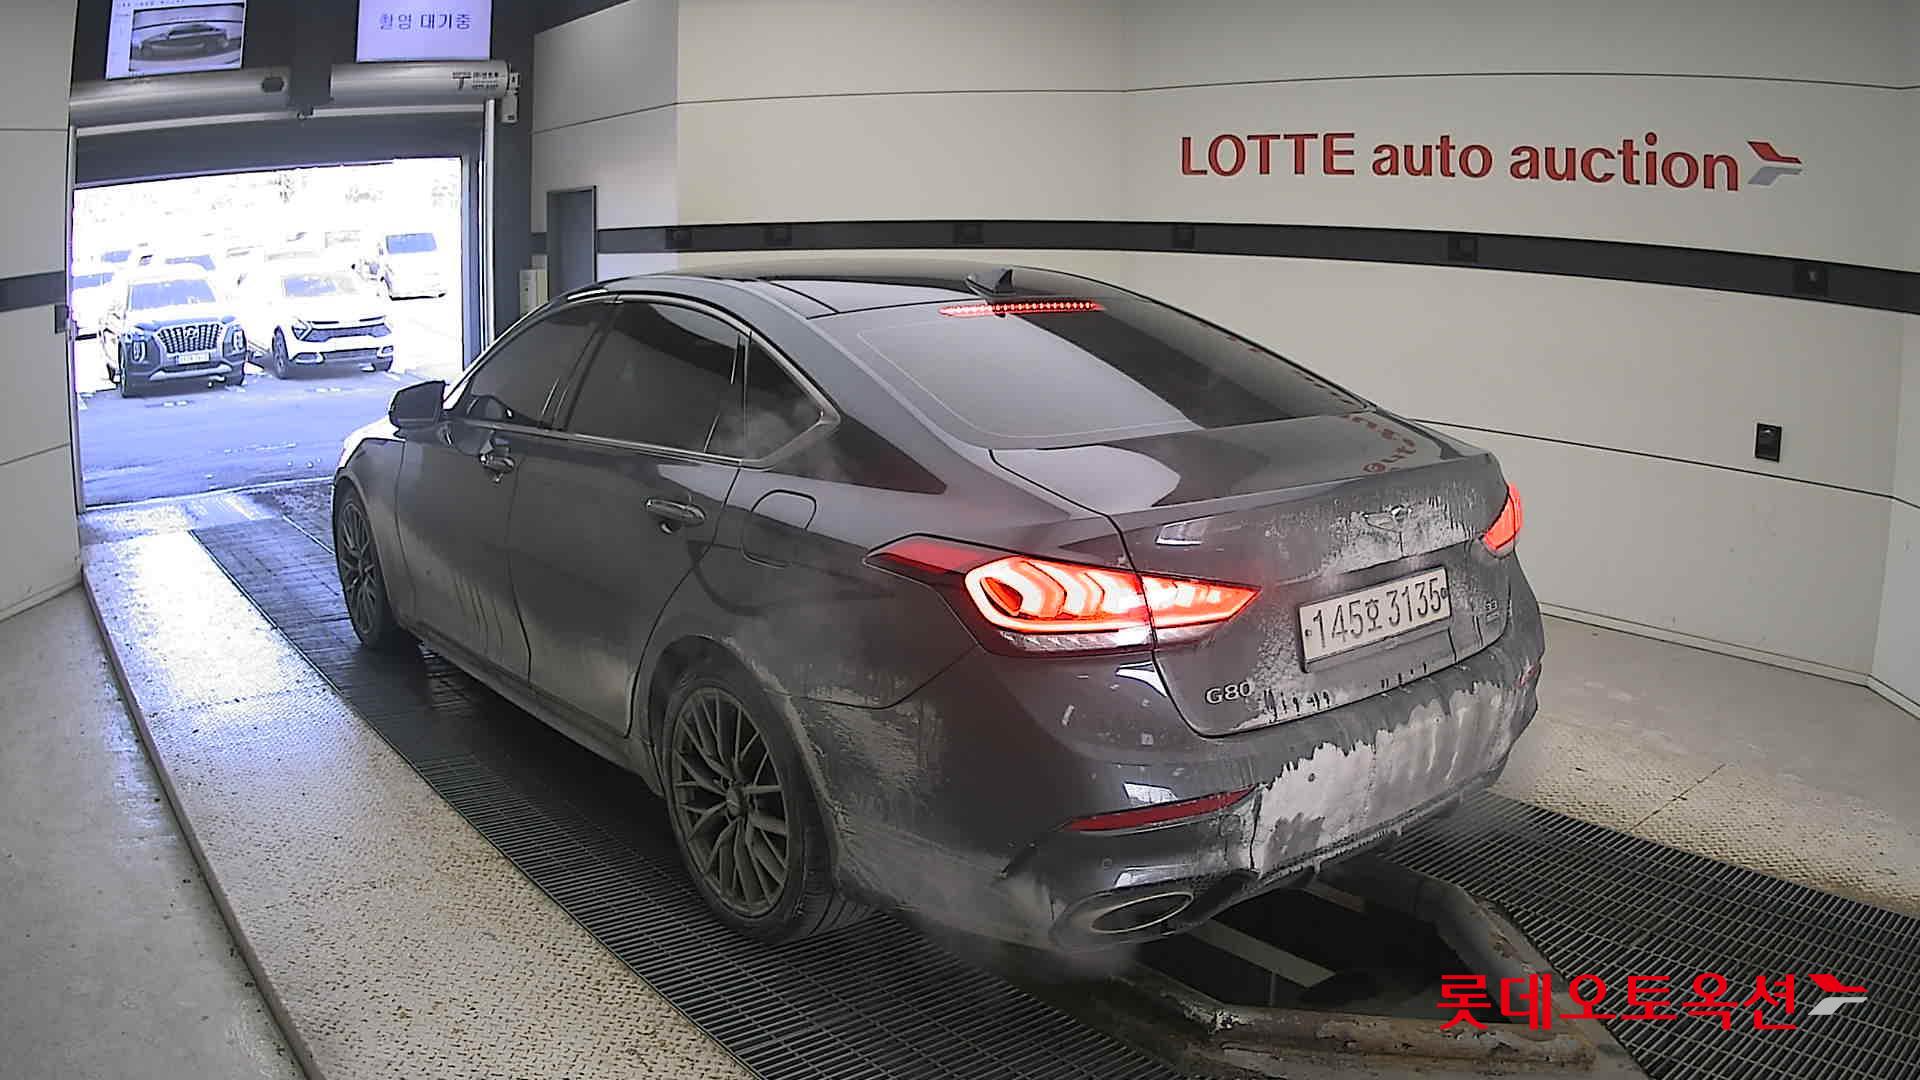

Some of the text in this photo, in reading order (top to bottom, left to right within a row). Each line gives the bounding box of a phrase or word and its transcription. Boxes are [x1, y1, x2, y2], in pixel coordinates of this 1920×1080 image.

[420, 13, 472, 30] 대기중
[1181, 132, 1740, 192] LOTTE auto auction
[1312, 598, 1383, 649] 145호
[1385, 577, 1442, 627] 3135
[1206, 681, 1252, 704] G80
